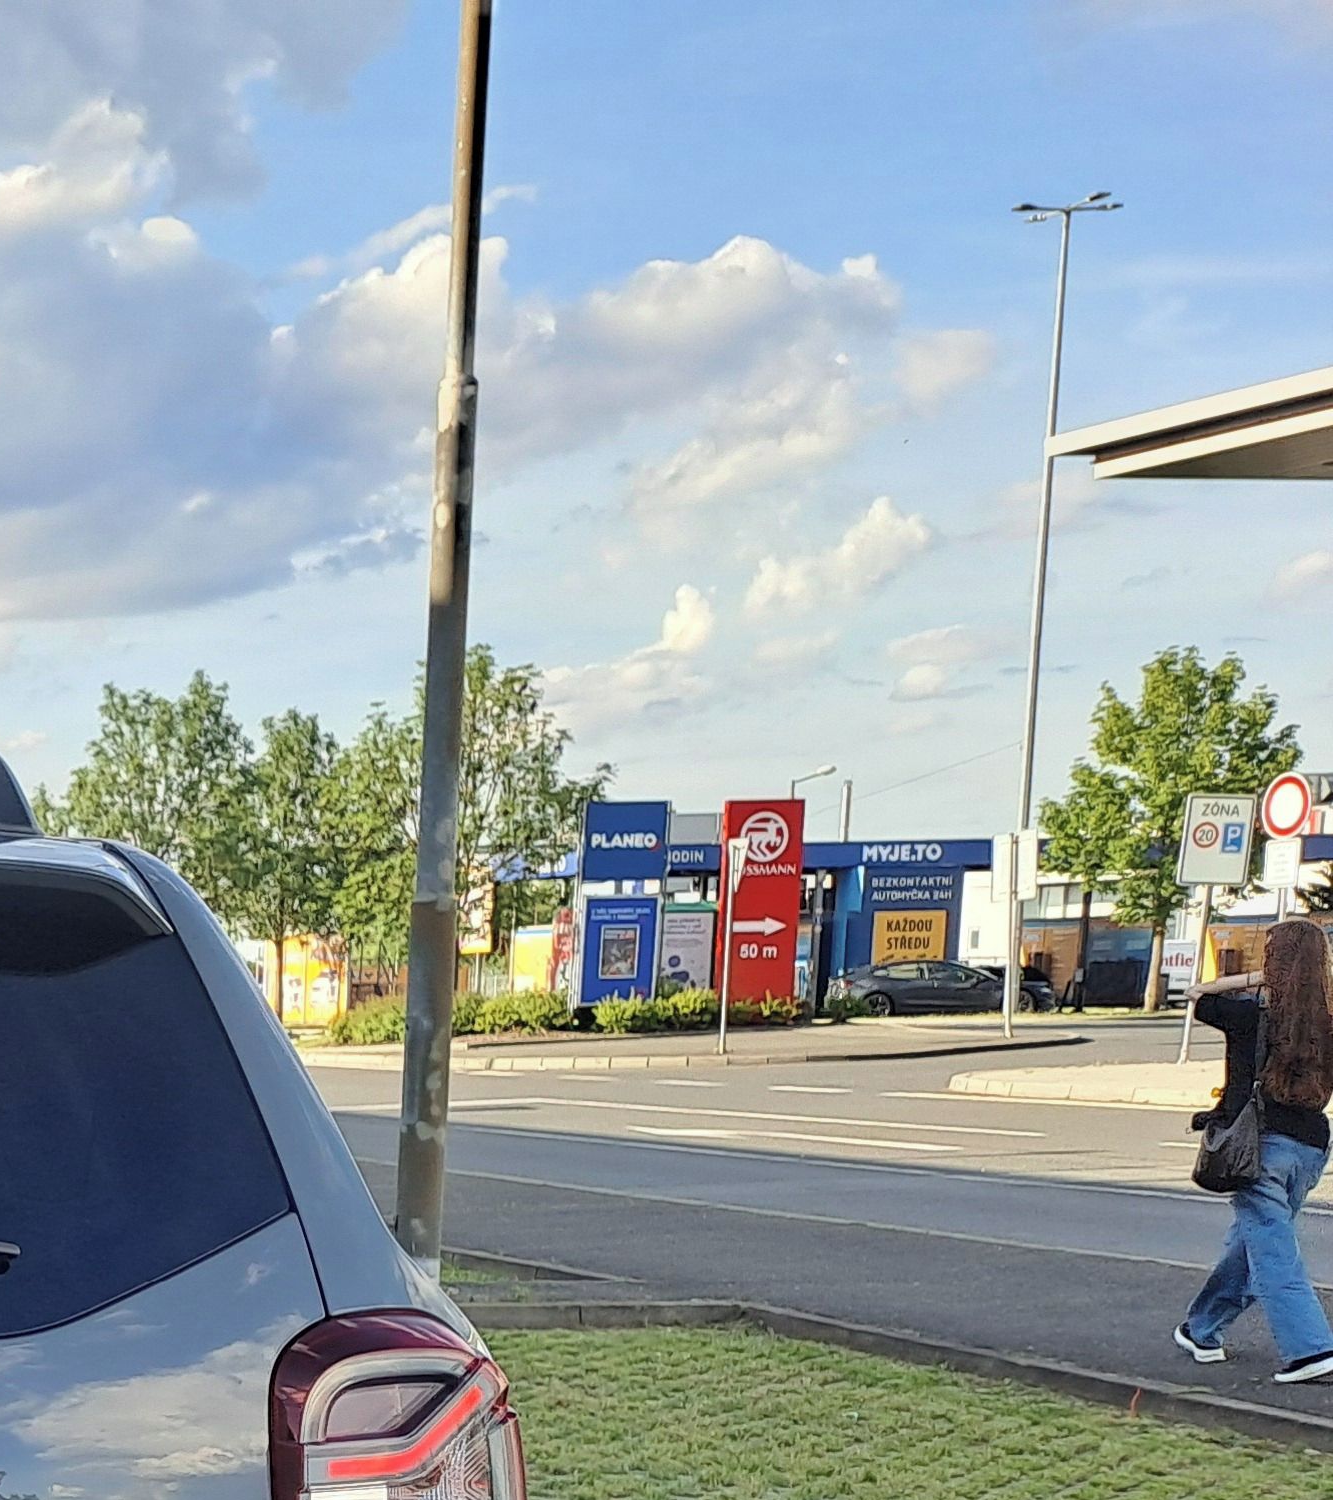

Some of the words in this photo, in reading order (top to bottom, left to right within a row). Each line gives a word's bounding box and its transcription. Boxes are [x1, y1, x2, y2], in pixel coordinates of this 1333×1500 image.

[1201, 801, 1240, 817] ZÓNA
[591, 833, 657, 848] PLANEO
[1198, 829, 1213, 842] 20
[862, 843, 942, 862] MYJE.TO
[742, 864, 796, 876] SSMANN
[871, 875, 952, 888] BEZKONTAKTNÍ
[871, 888, 930, 901] AUTOMYČKA
[886, 917, 933, 932] KAŽDOU
[886, 936, 930, 950] STŘEDU
[740, 943, 757, 958] 50
[762, 945, 778, 958] m
